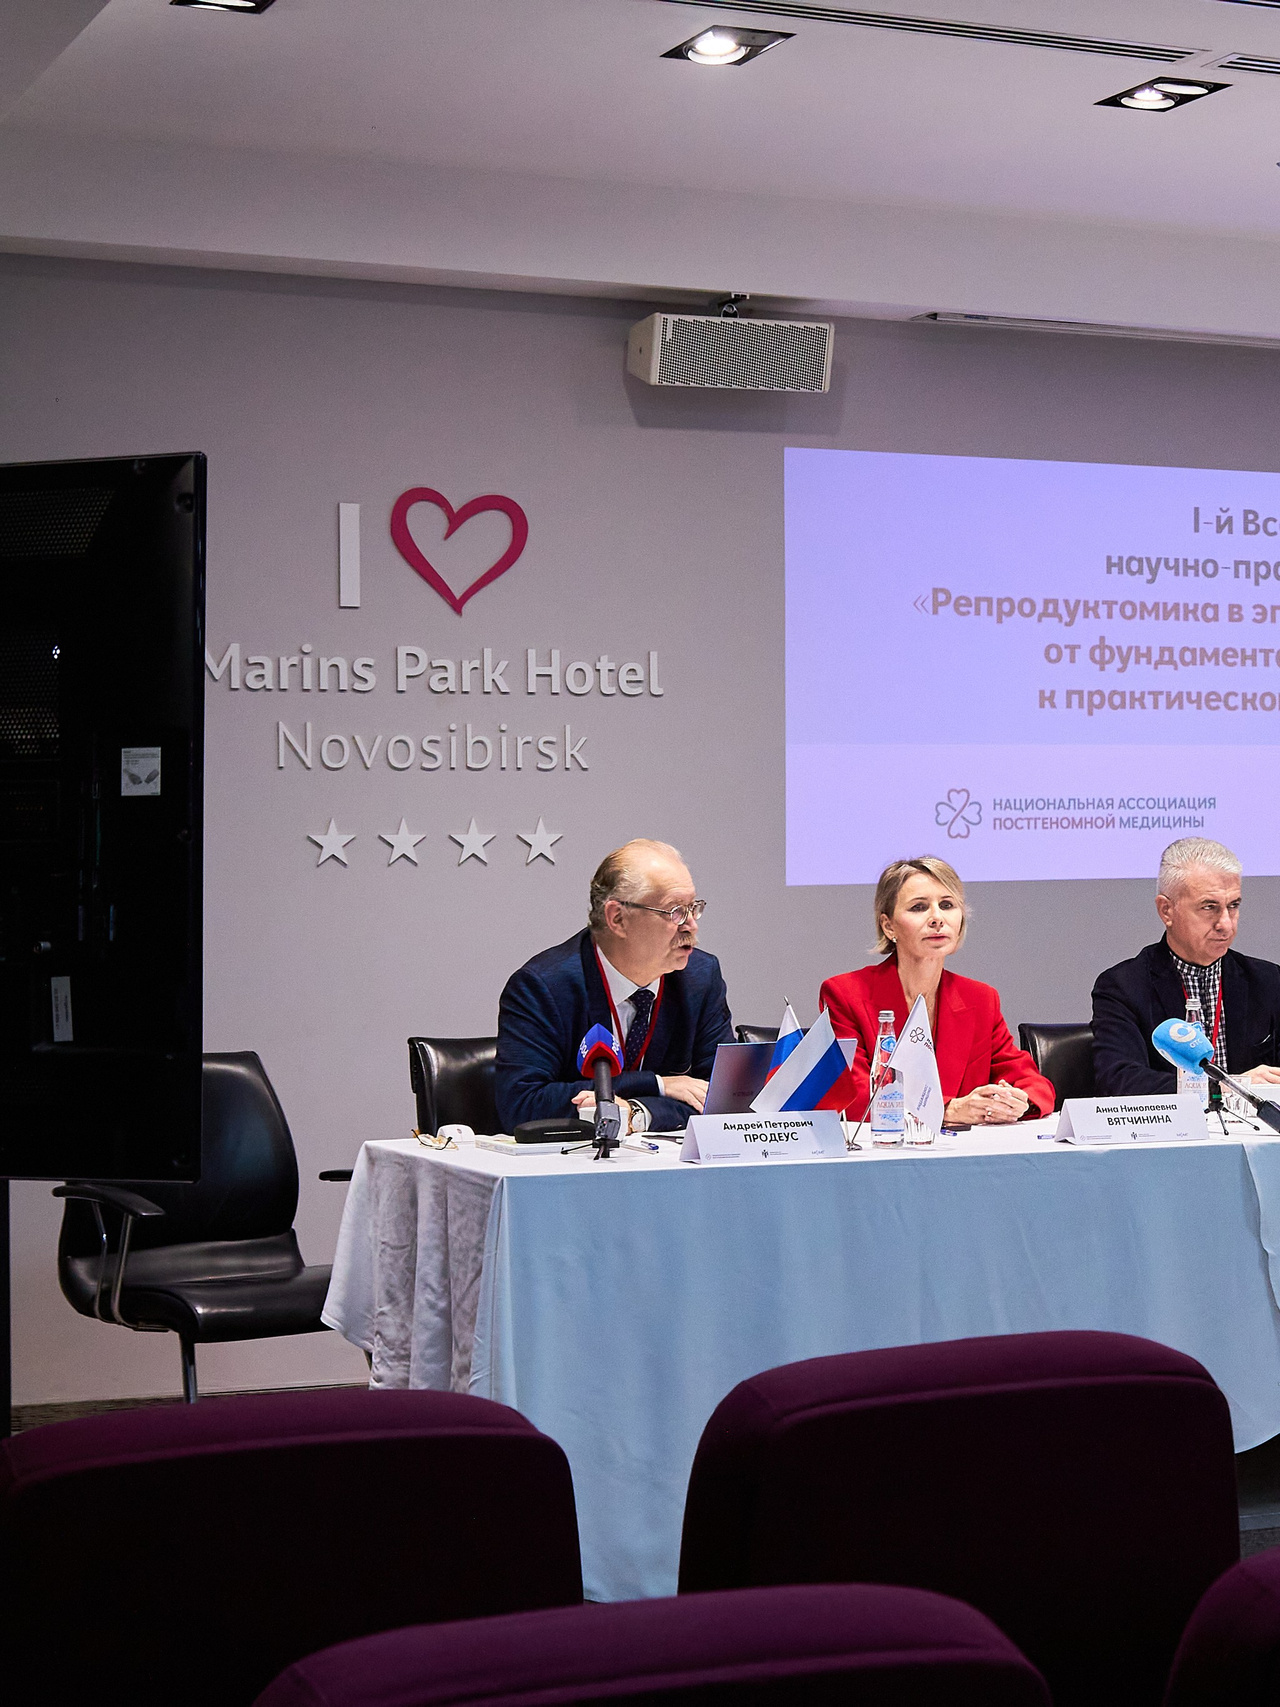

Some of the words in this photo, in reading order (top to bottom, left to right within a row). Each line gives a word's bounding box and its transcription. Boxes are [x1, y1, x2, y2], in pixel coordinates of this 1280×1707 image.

[339, 502, 361, 608] I
[912, 586, 1220, 628] «Репродуктомика
[1227, 603, 1246, 623] в
[1043, 643, 1082, 665] от
[205, 643, 376, 693] Marins
[396, 645, 510, 695] Park
[526, 648, 664, 697] Hotel
[1038, 689, 1058, 709] к
[277, 720, 590, 771] Novosibirsk
[993, 796, 1114, 813] НАЦИОНАЛЬНАЯ
[1118, 796, 1217, 813] АССОЦИАЦИЯ
[993, 812, 1116, 831] ПОСТГЕНОМНОЙ
[1118, 815, 1205, 830] МЕДИЦИНЫ
[1095, 1105, 1119, 1114] Анна
[1119, 1103, 1178, 1113] Николаевна
[723, 1120, 763, 1131] Андрей
[765, 1120, 814, 1131] Петрович
[1107, 1115, 1172, 1126] ВЯТЧИНИНА
[743, 1132, 799, 1143] ПРОДЕУС
